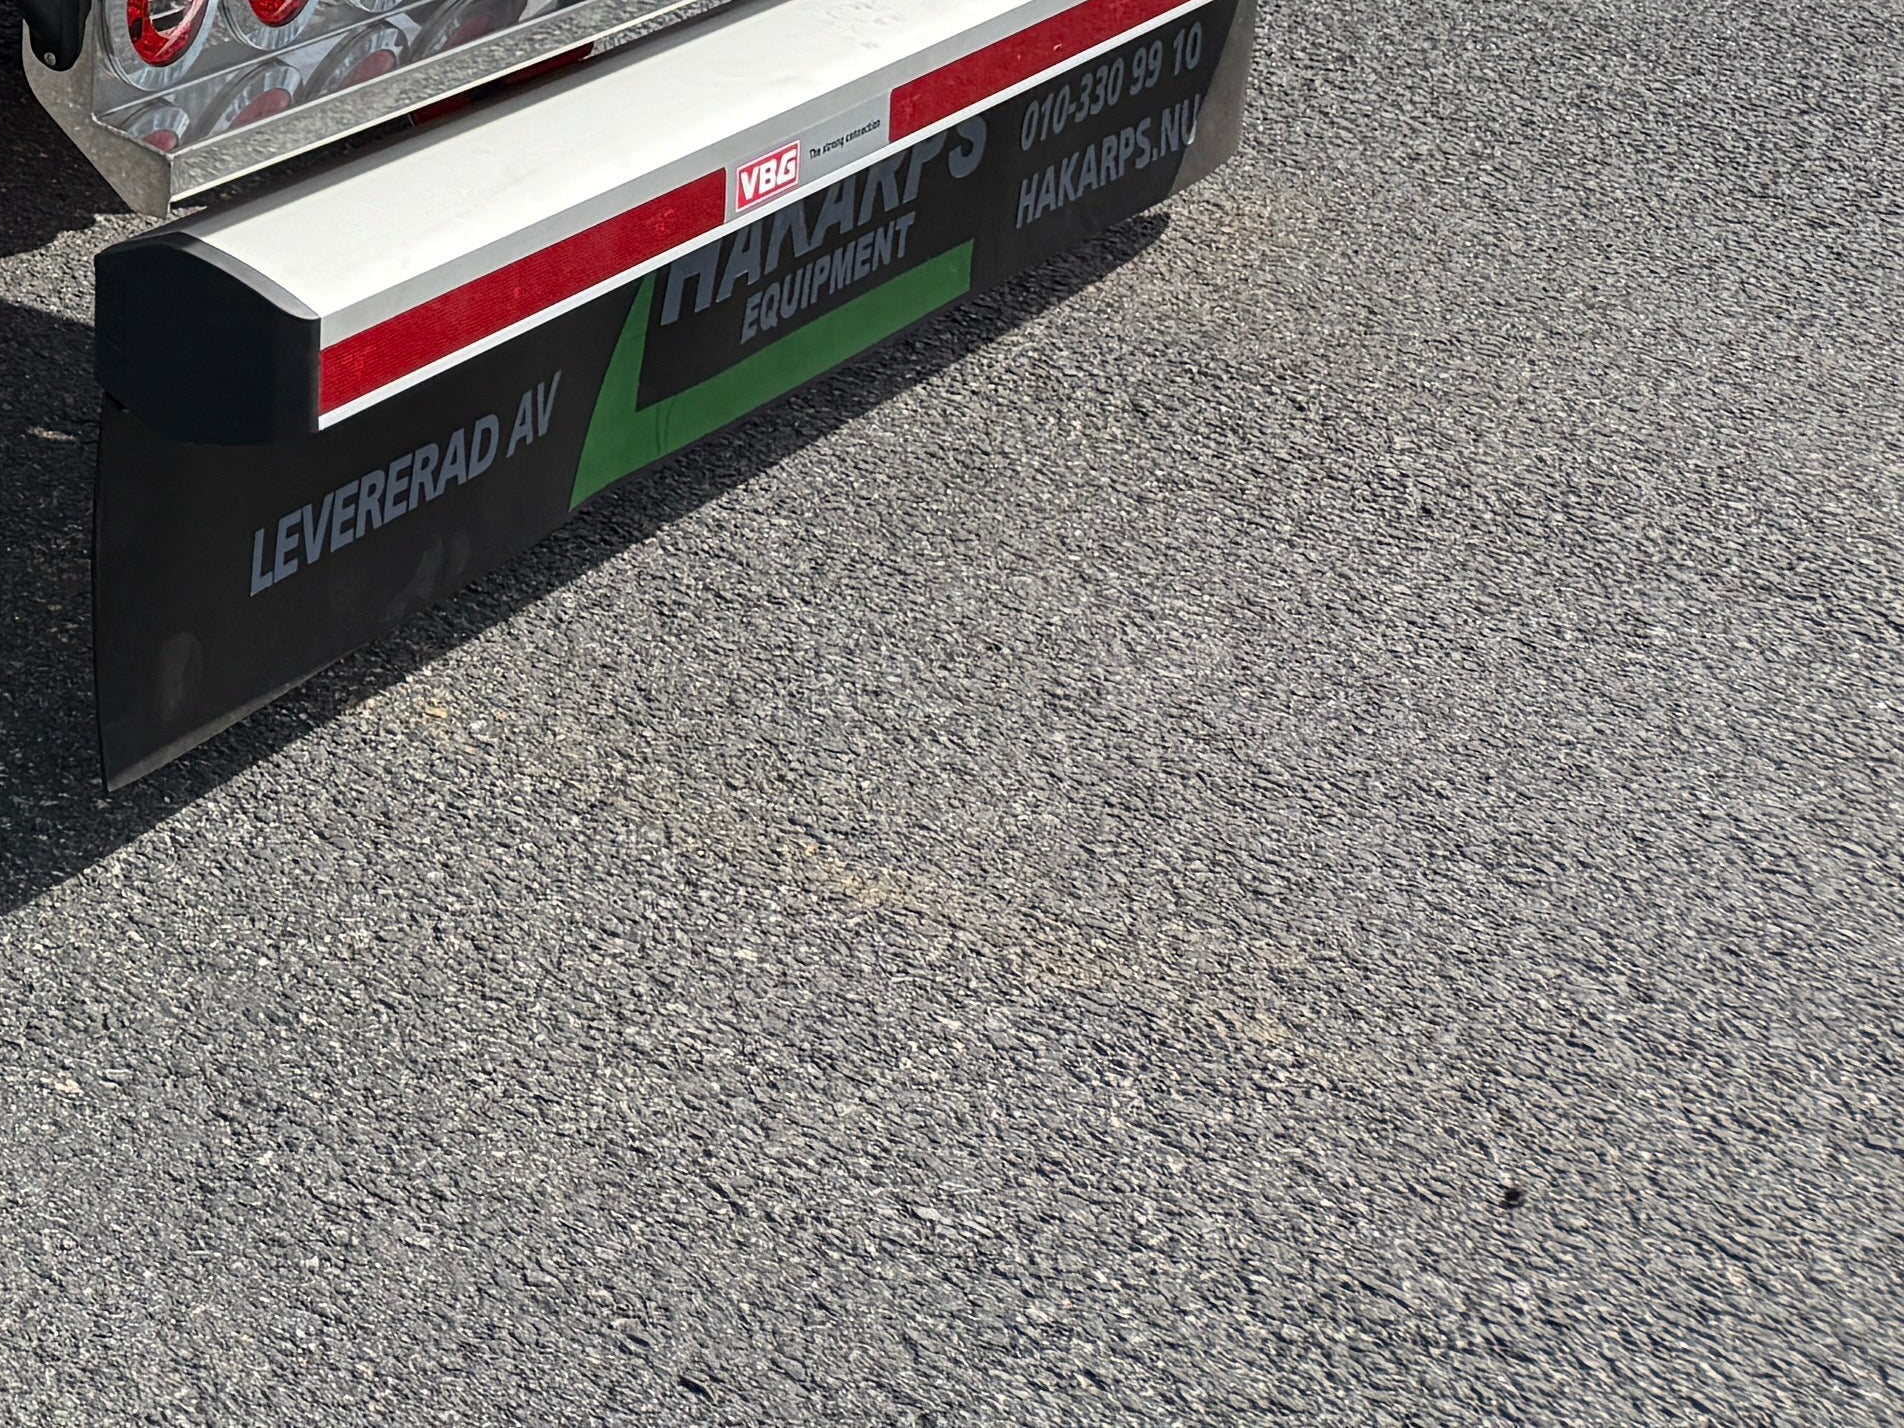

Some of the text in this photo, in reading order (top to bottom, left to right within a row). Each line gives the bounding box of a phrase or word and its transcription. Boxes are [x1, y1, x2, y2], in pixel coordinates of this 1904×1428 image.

[809, 119, 881, 160] The strong connection
[1021, 21, 1202, 151] 010-330 99 10
[740, 148, 797, 201] VBG
[1016, 93, 1200, 230] HAKARPS.NU
[741, 211, 917, 344] EQUIPMENT
[250, 369, 562, 598] LEVERERAD AV
